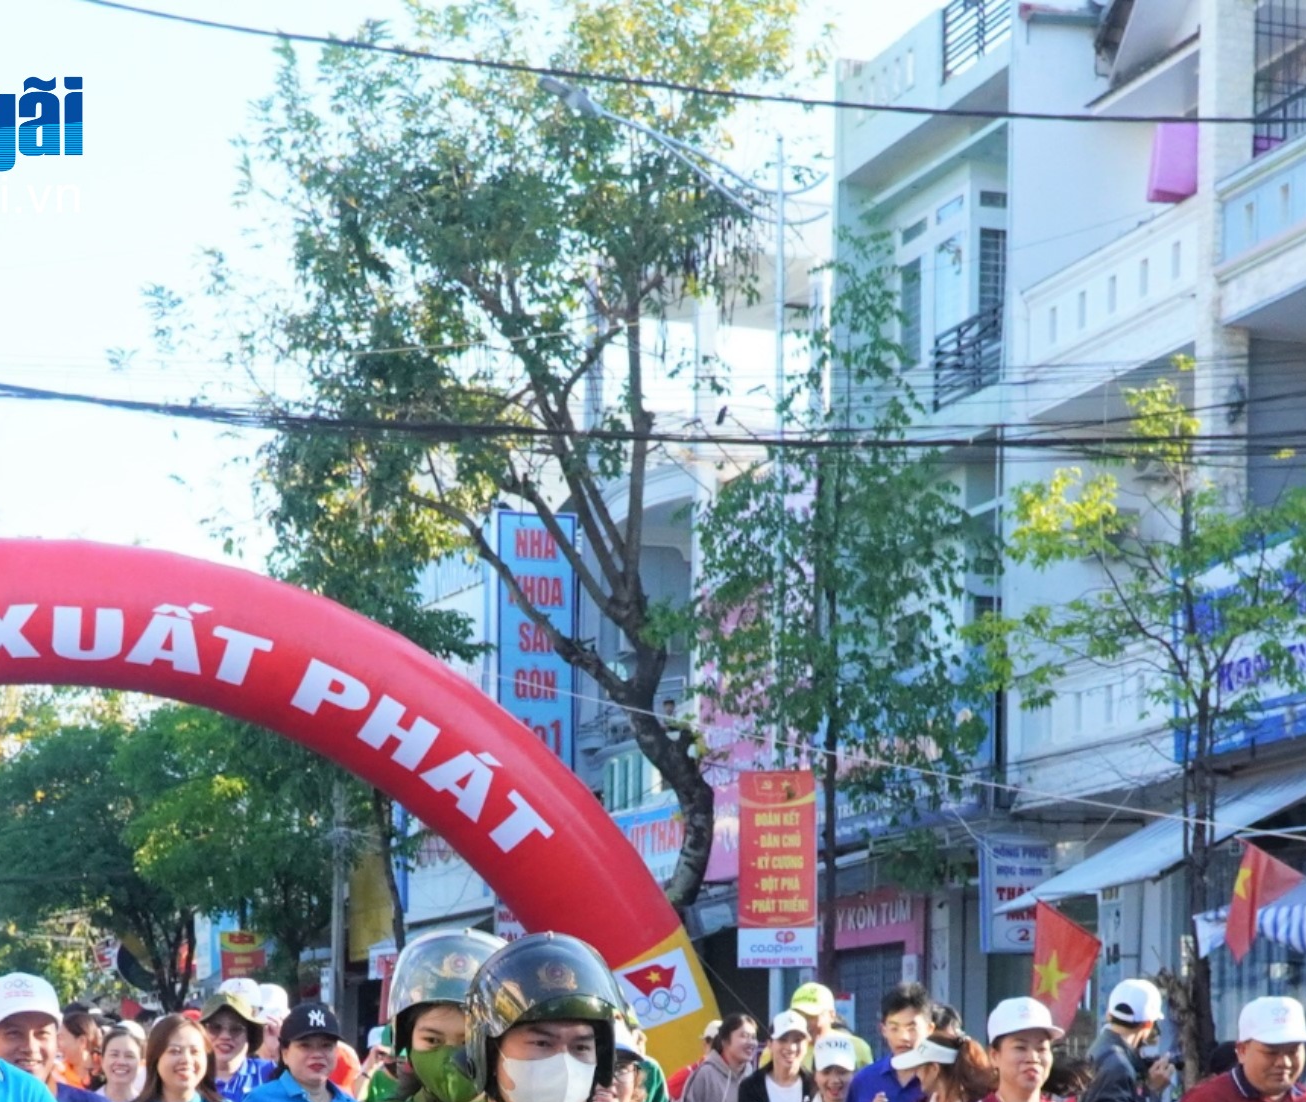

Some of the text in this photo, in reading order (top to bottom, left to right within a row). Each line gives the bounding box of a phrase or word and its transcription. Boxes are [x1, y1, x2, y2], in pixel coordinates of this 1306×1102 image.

[291, 659, 555, 854] PHÁT
[847, 904, 878, 931] KON
[880, 896, 912, 927] TUM
[1017, 929, 1031, 942] 2
[308, 1009, 326, 1028] NY
